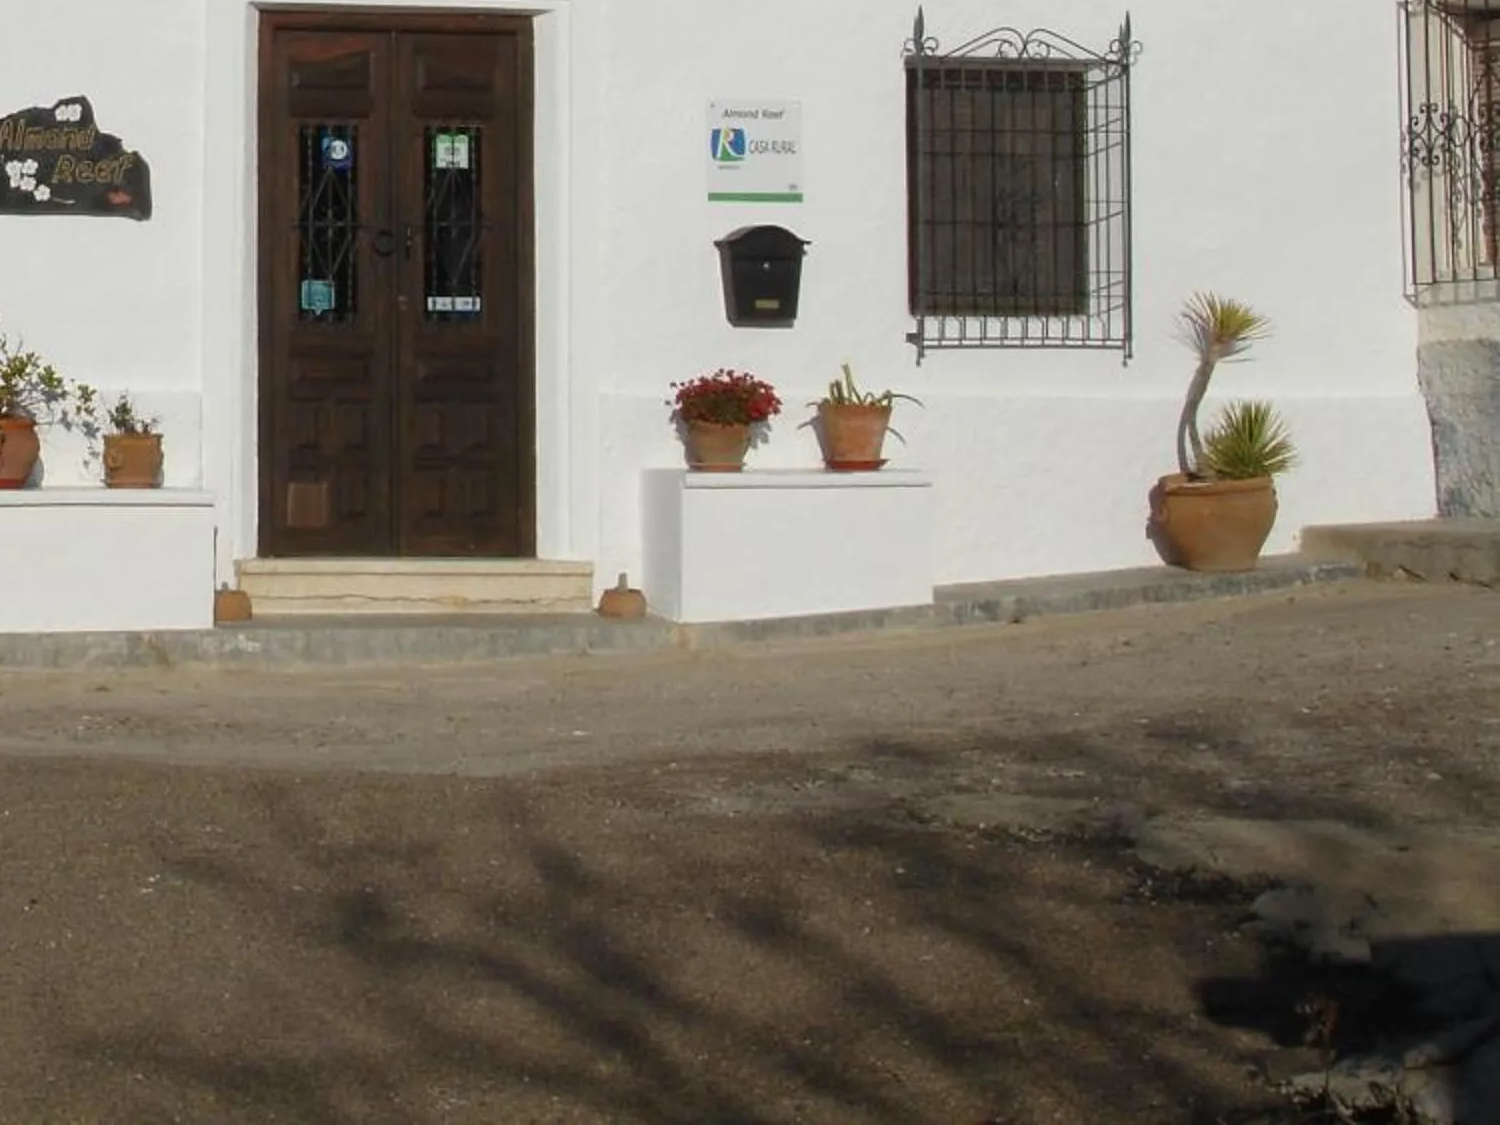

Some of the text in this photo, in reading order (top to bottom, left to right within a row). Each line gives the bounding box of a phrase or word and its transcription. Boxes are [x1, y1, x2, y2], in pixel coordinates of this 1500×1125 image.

[722, 109, 759, 119] Almond
[748, 140, 769, 154] CASA
[51, 154, 133, 184] Reef
